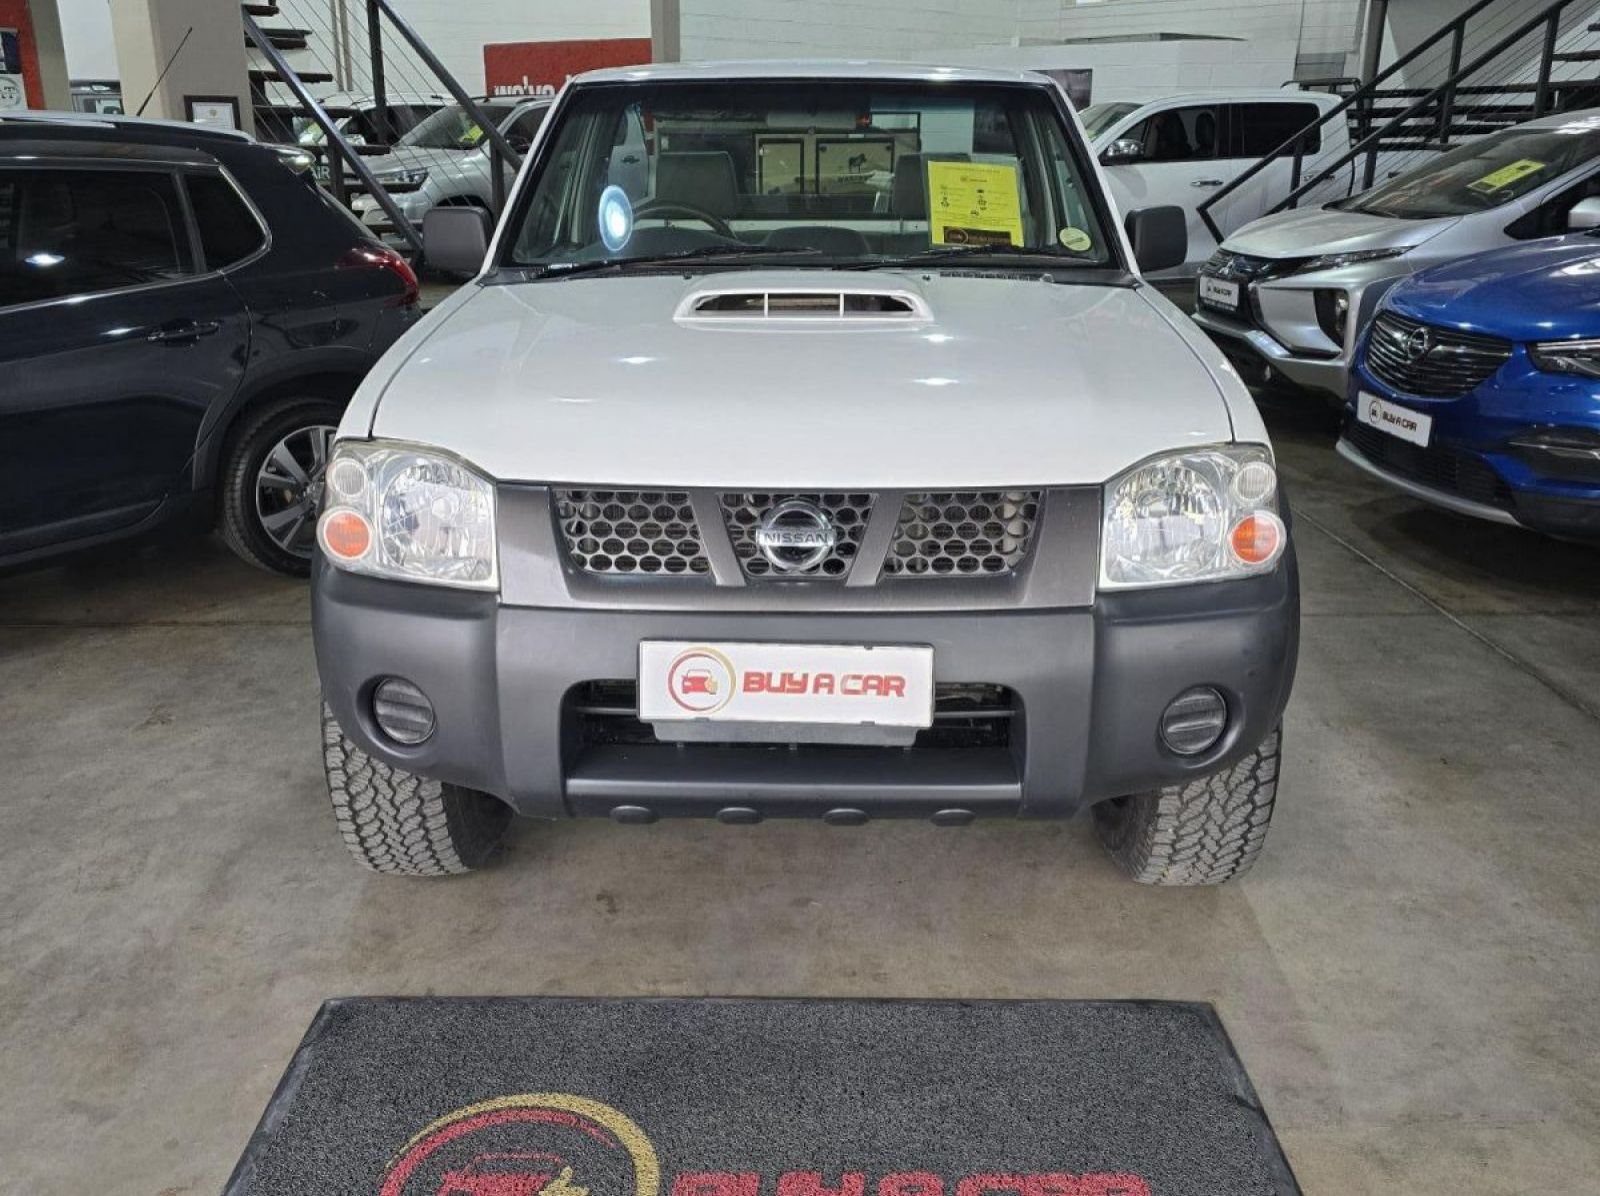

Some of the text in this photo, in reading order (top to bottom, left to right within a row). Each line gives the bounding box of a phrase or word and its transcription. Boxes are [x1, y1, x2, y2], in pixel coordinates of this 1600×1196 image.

[764, 532, 828, 544] NISSAN
[743, 671, 906, 697] BUY A CAR
